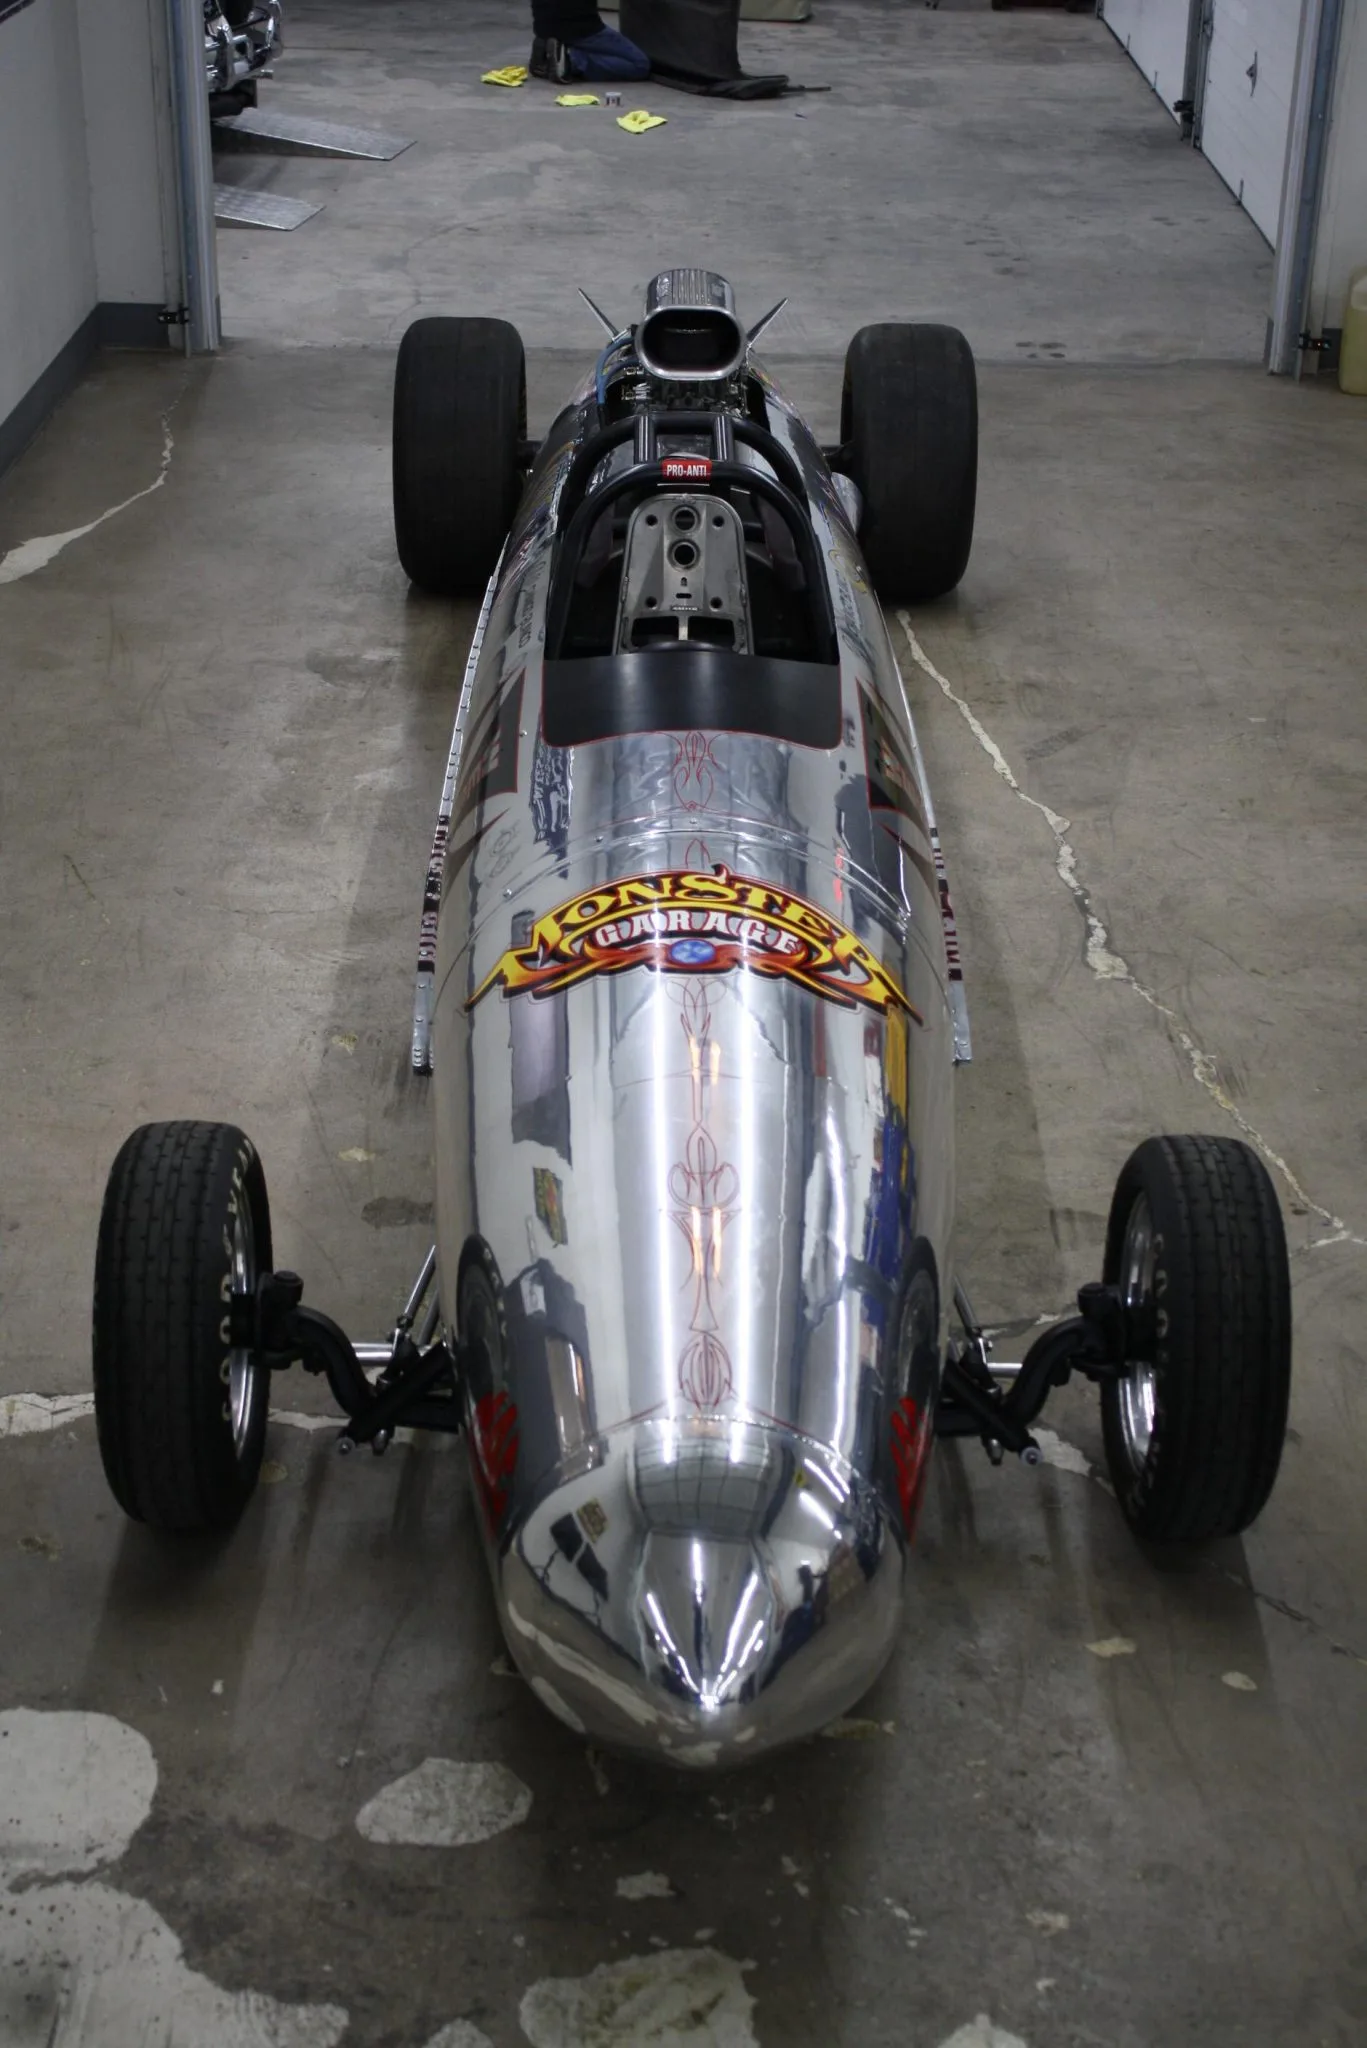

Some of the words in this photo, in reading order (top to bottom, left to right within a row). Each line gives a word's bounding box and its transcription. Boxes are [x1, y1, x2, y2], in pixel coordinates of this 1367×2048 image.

[666, 464, 707, 477] PRO-ANTI
[465, 866, 923, 1024] MONSTER
[594, 909, 802, 956] GARAGE
